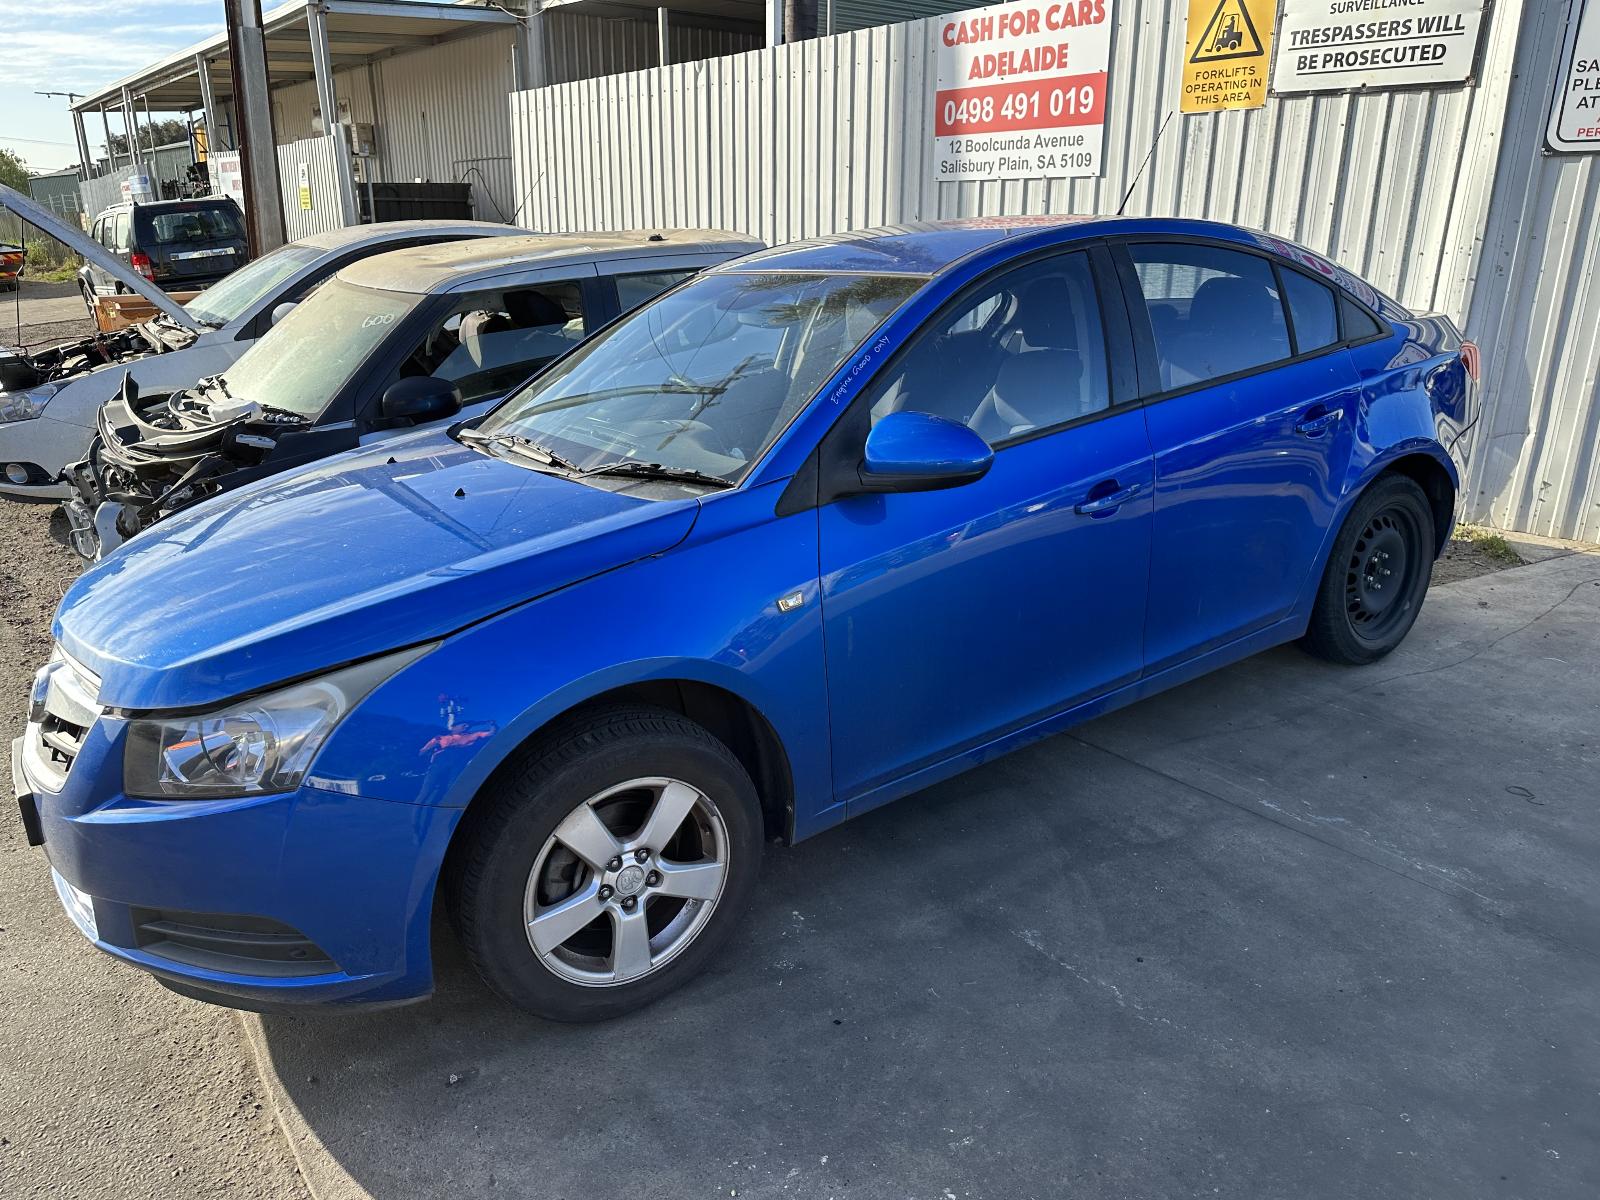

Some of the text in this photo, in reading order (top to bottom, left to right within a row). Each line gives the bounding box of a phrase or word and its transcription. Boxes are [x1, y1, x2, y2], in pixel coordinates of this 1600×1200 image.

[942, 0, 1106, 47] CASH FOR CARS
[1290, 13, 1466, 46] TRESPASSERS WILL
[968, 43, 1069, 80] ADELAIDE
[1296, 43, 1447, 71] BE PROSECUTED
[1185, 77, 1262, 94] OPERATING IN
[1195, 65, 1256, 81] FORKLIFTS
[944, 85, 1094, 126] 0498 491 019
[1194, 91, 1251, 105] THIS AREA
[949, 134, 1084, 154] 12 Boolcunda Avenue
[940, 152, 1092, 175] Salisbury Plain, SA 5109
